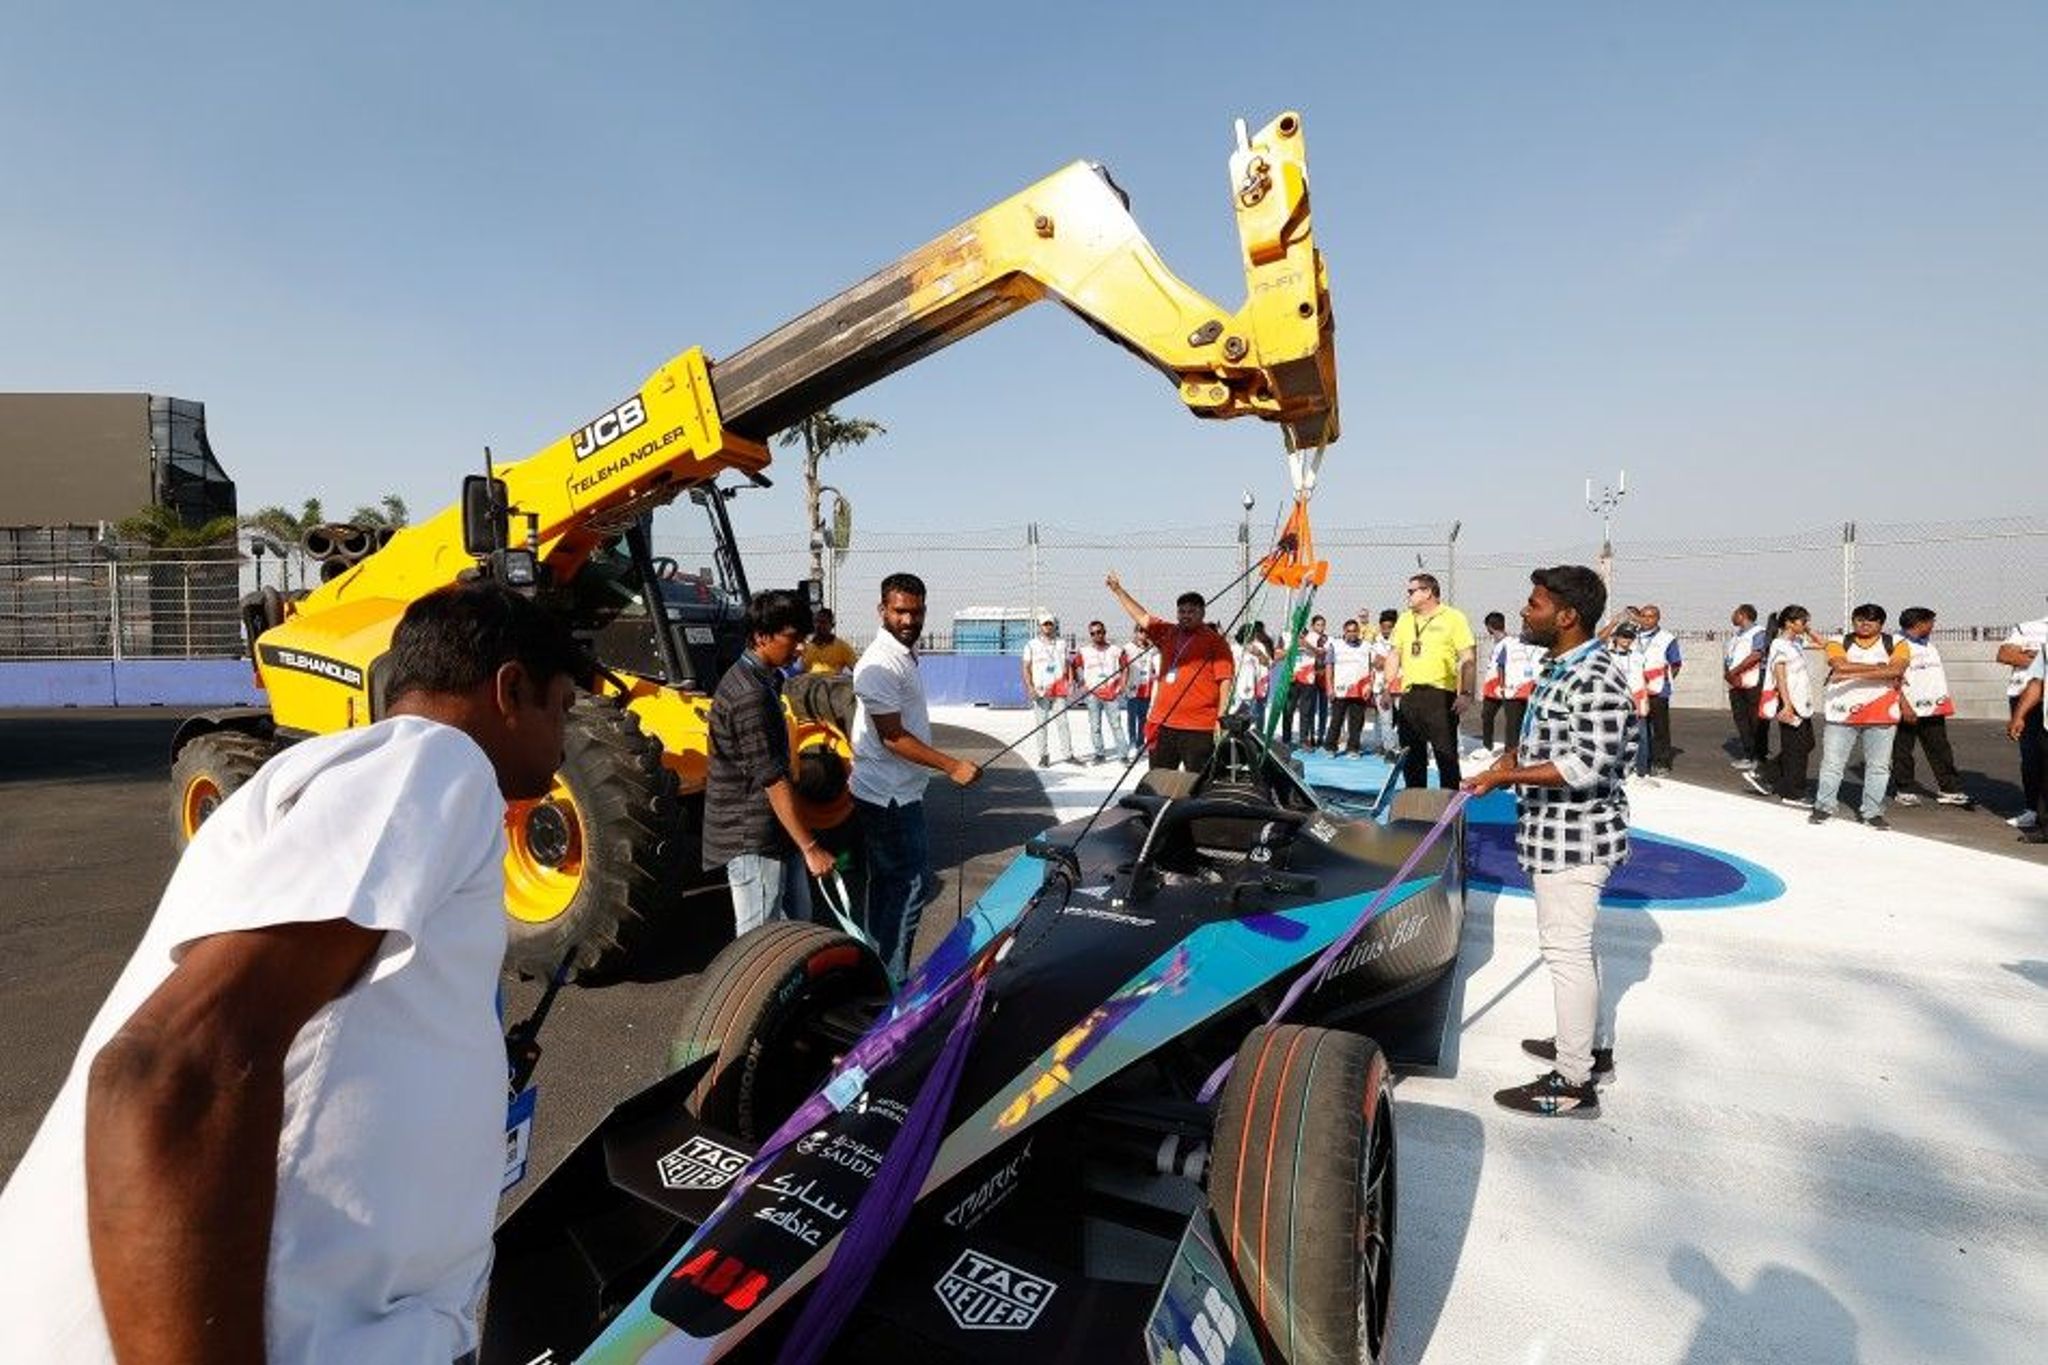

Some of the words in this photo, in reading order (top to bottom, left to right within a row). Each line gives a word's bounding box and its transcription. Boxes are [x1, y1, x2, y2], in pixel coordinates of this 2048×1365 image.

[575, 397, 646, 459] JCB
[571, 425, 685, 495] TELEHANDLER
[278, 650, 361, 686] TELEHANDLER
[664, 1155, 724, 1186] HEUER
[687, 1140, 745, 1173] TAG
[753, 1207, 822, 1246] sabic
[671, 1248, 769, 1311] ABB
[943, 1278, 1029, 1323] HEUER
[967, 1257, 1044, 1304] TAG
